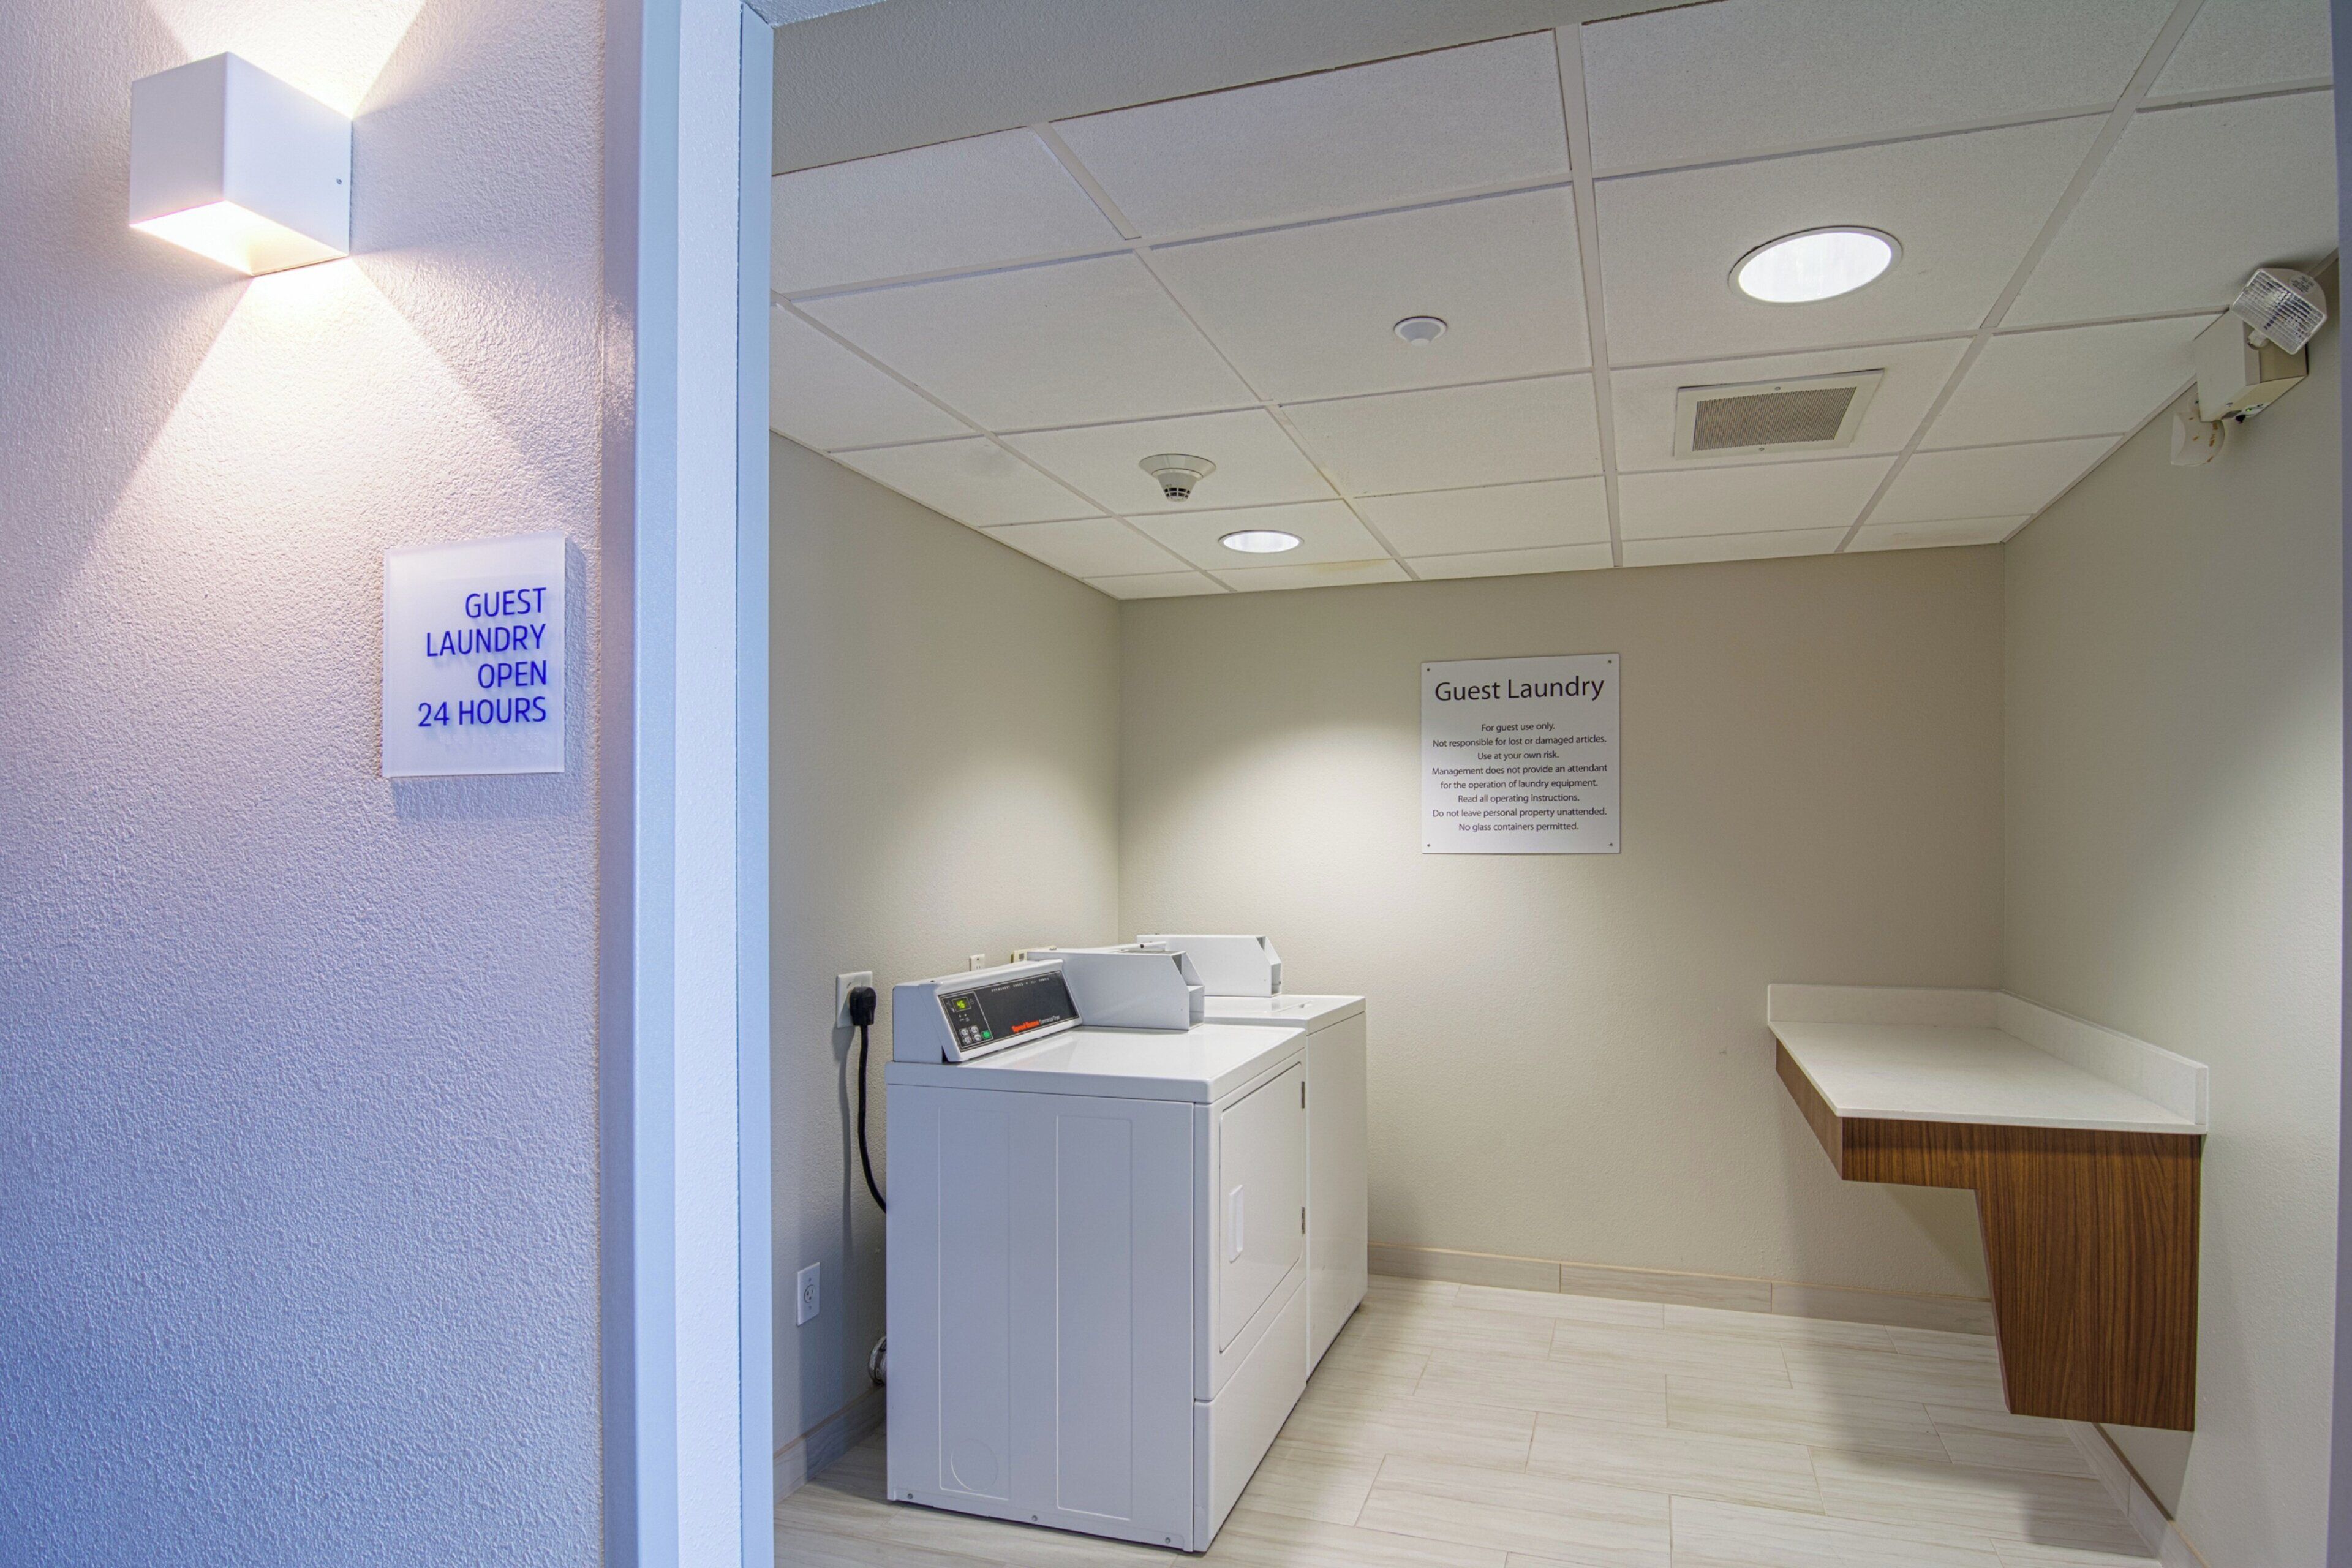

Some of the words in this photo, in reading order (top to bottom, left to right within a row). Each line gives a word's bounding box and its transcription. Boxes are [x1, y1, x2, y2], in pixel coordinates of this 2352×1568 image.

[466, 587, 546, 618] GUEST
[427, 624, 545, 657] LAUNDRY
[478, 660, 546, 689] OPEN
[1435, 682, 1501, 701] Guest
[1509, 676, 1604, 701] Laundry
[419, 702, 450, 727] 24
[459, 696, 546, 725] HOURS
[1496, 724, 1518, 733] guest
[1536, 722, 1555, 731] only.
[1449, 738, 1493, 748] responsible
[1535, 736, 1574, 745] damaged
[1432, 768, 1483, 777] Management
[1523, 765, 1553, 775] provide
[1567, 764, 1607, 772] attendant
[1468, 781, 1506, 790] operation
[1519, 780, 1549, 789] laundry
[1551, 779, 1598, 788] equipment.
[1490, 794, 1529, 804] operating
[1483, 809, 1517, 818] personal
[1557, 807, 1607, 816] unattended.
[1472, 823, 1491, 832] glass
[1536, 822, 1578, 832] permitted.
